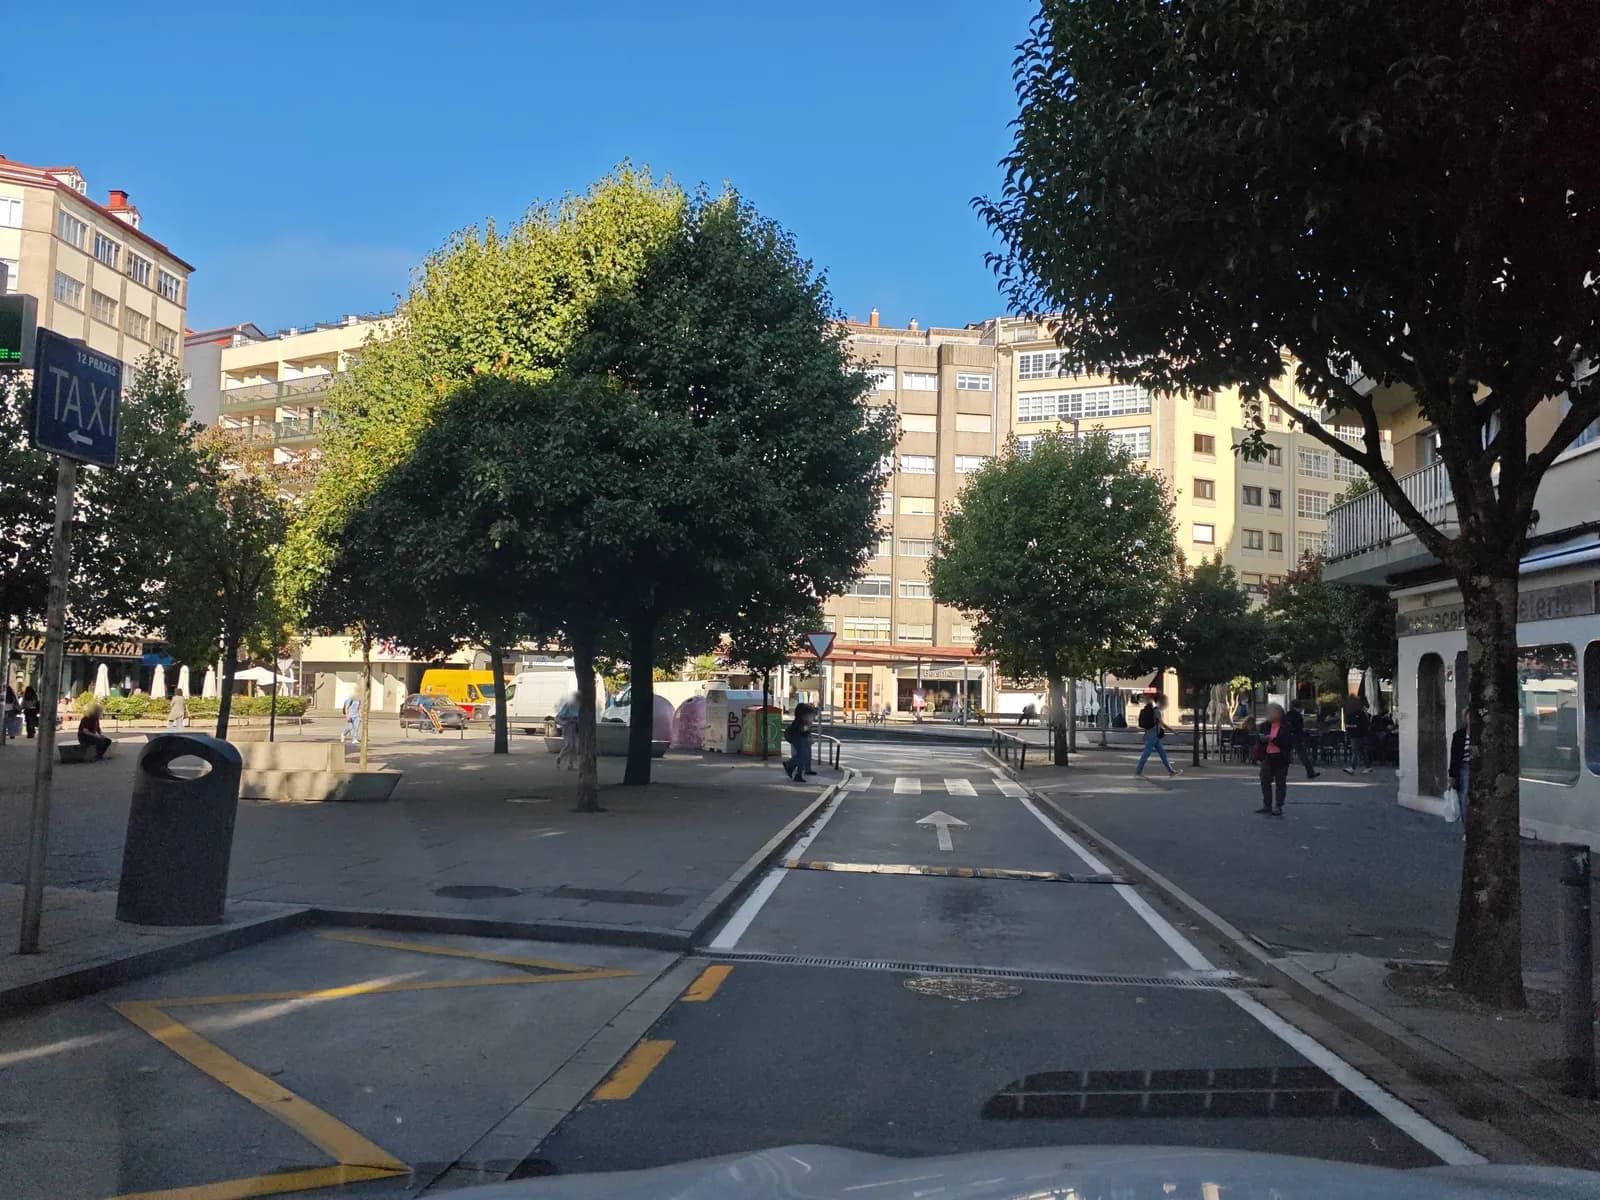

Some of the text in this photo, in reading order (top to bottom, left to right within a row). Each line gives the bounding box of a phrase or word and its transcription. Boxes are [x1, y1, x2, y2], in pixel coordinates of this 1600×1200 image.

[77, 351, 117, 377] 12 PRAZAS
[48, 365, 115, 437] TAXI
